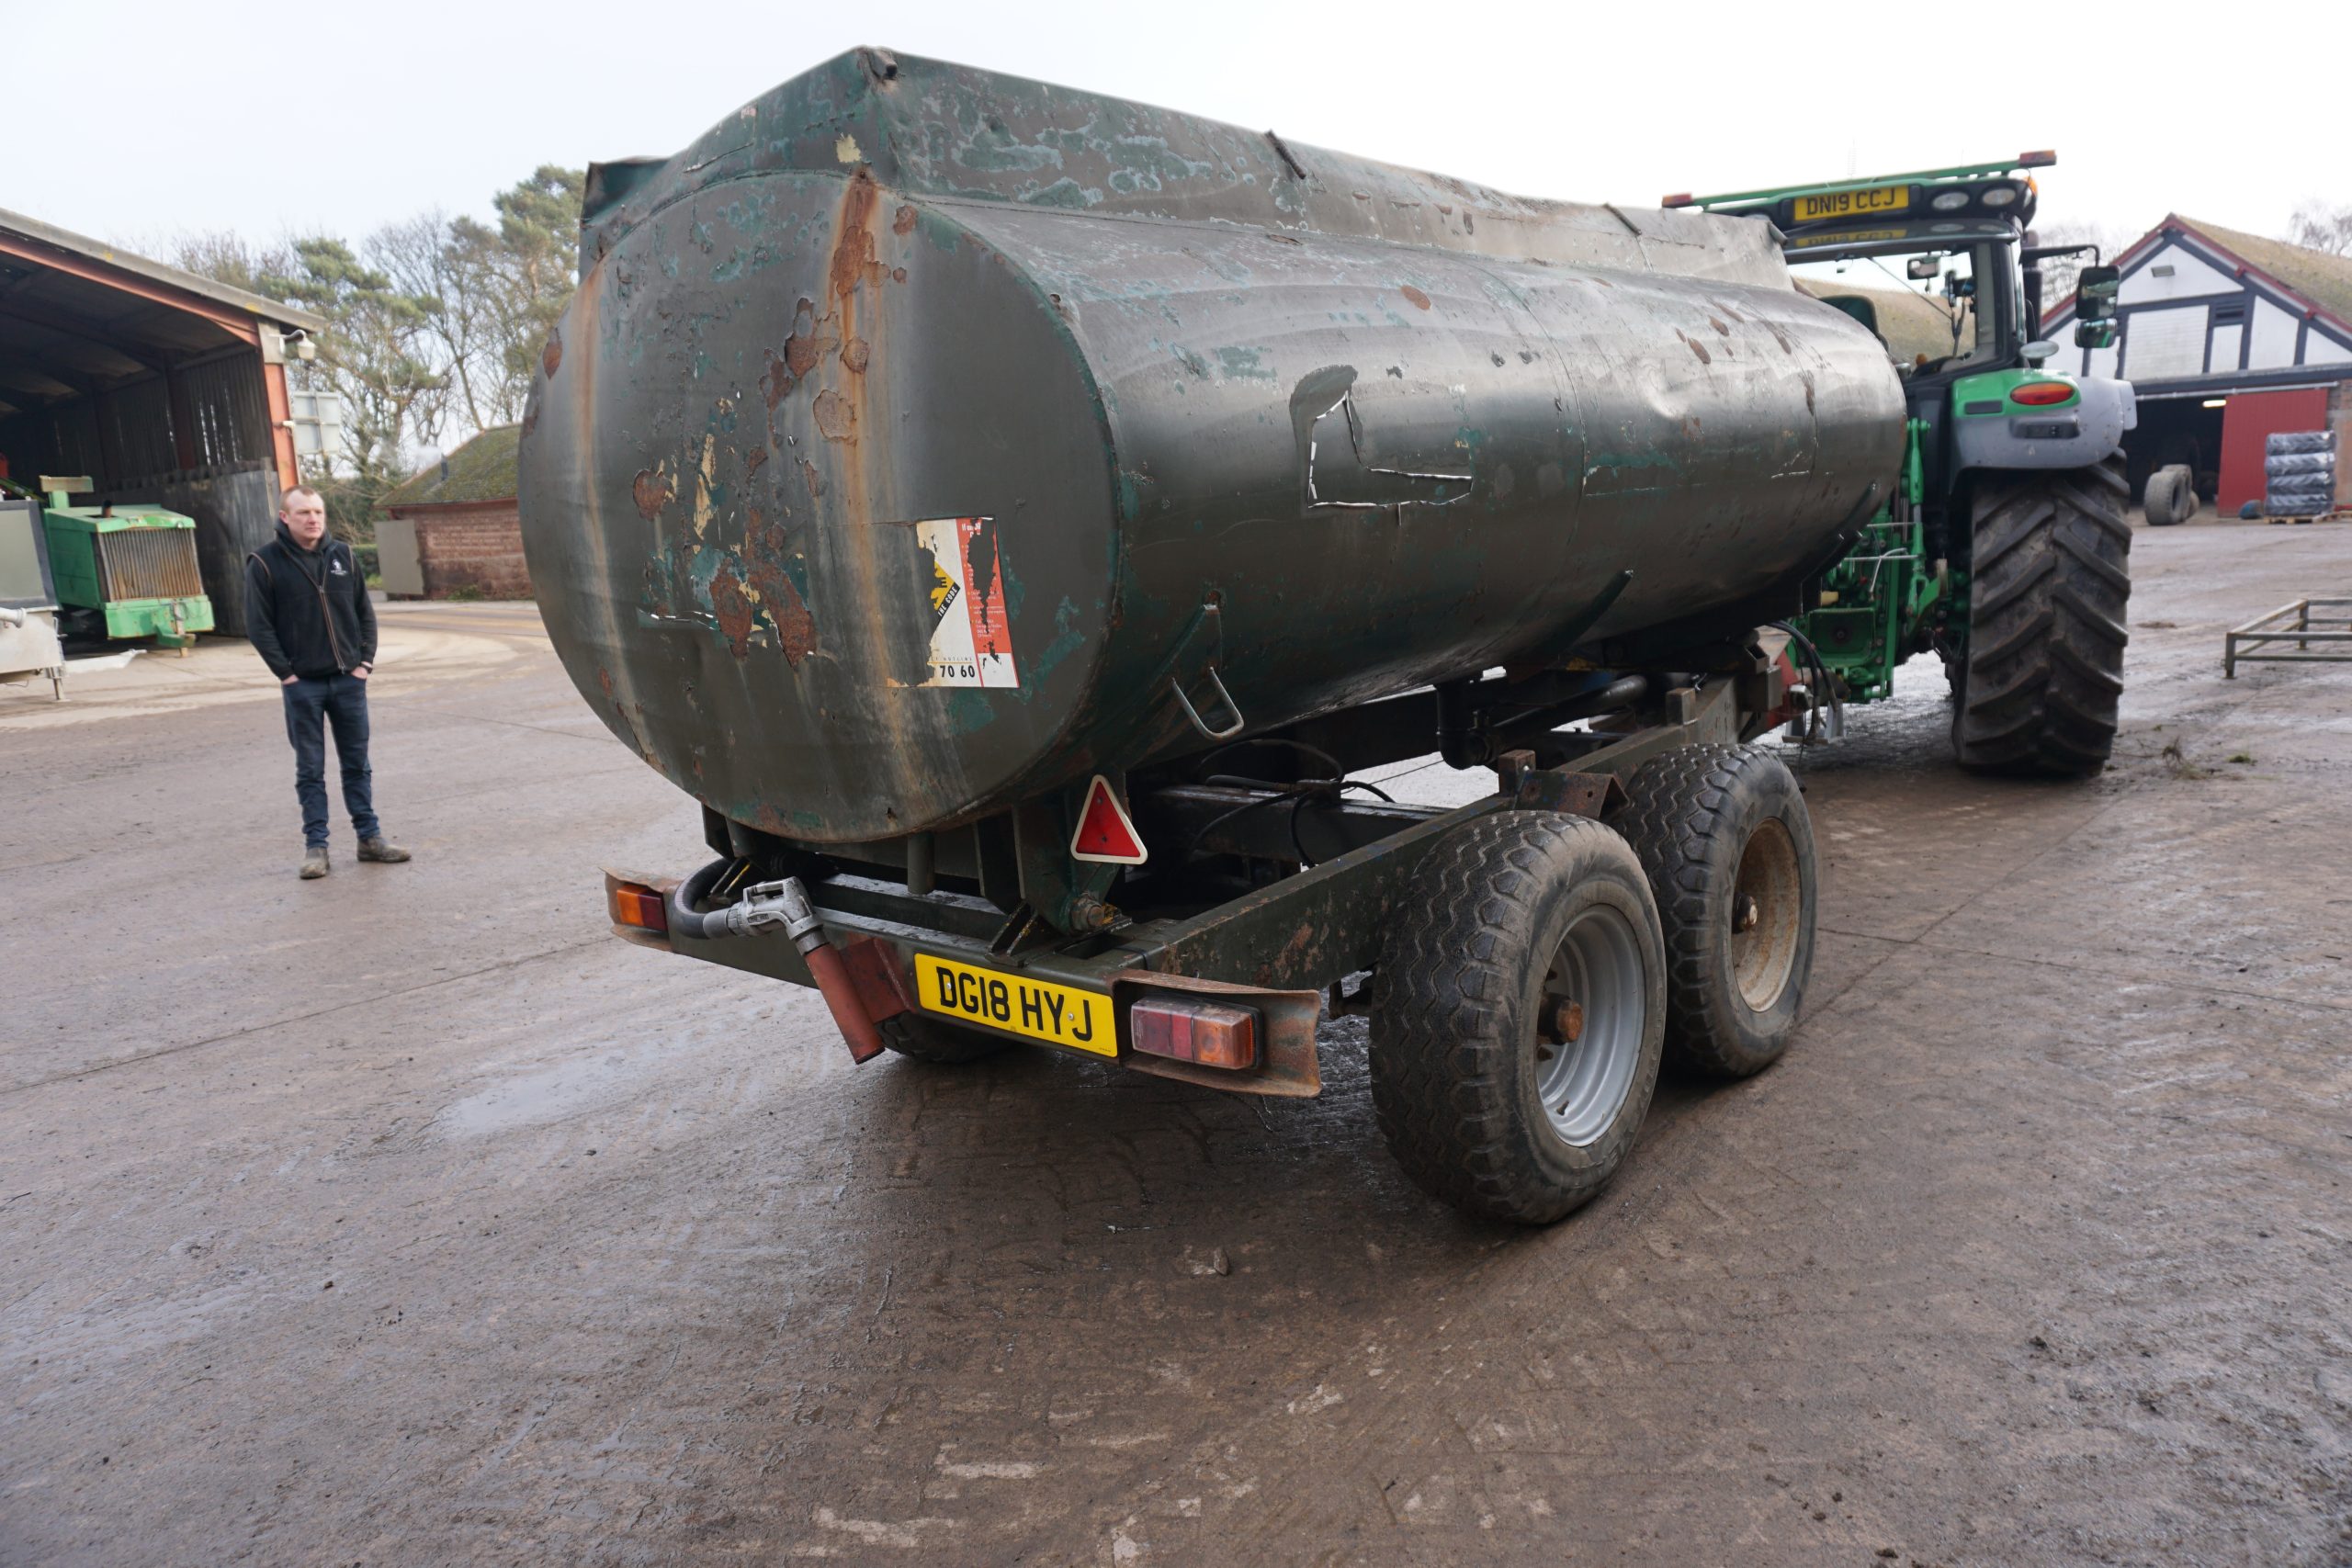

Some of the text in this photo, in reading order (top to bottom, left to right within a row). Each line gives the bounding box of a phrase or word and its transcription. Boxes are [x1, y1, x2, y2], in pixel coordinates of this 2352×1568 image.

[1807, 187, 1895, 215] DN19 CCJ
[945, 587, 957, 604] CODE
[940, 665, 976, 678] 70 60
[936, 966, 1011, 1022] DG18
[1020, 986, 1093, 1043] HYJ
